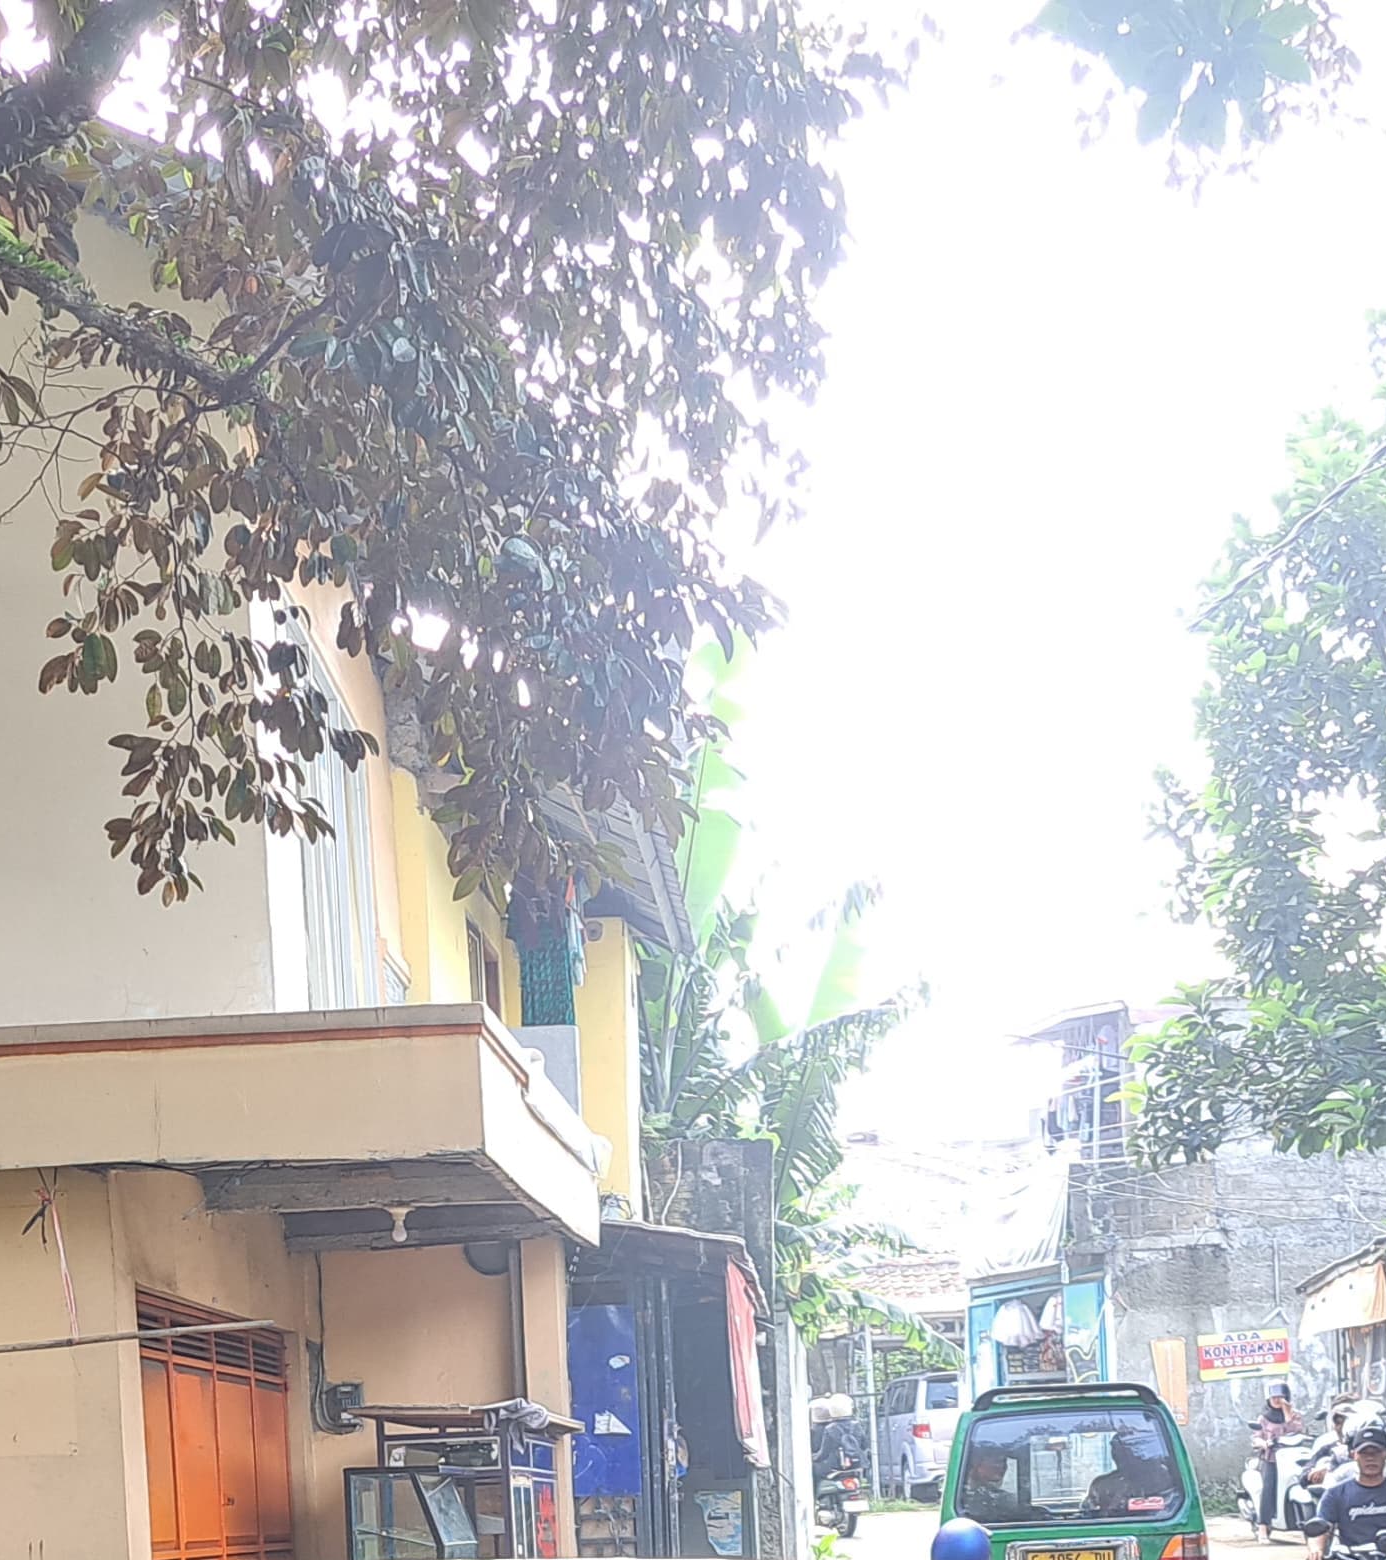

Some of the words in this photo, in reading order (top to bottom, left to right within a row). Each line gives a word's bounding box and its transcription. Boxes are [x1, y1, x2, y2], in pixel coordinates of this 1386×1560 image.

[1224, 1332, 1261, 1342] ADA
[1203, 1340, 1285, 1359] KONTRAKAN
[1213, 1355, 1275, 1368] KOSONG
